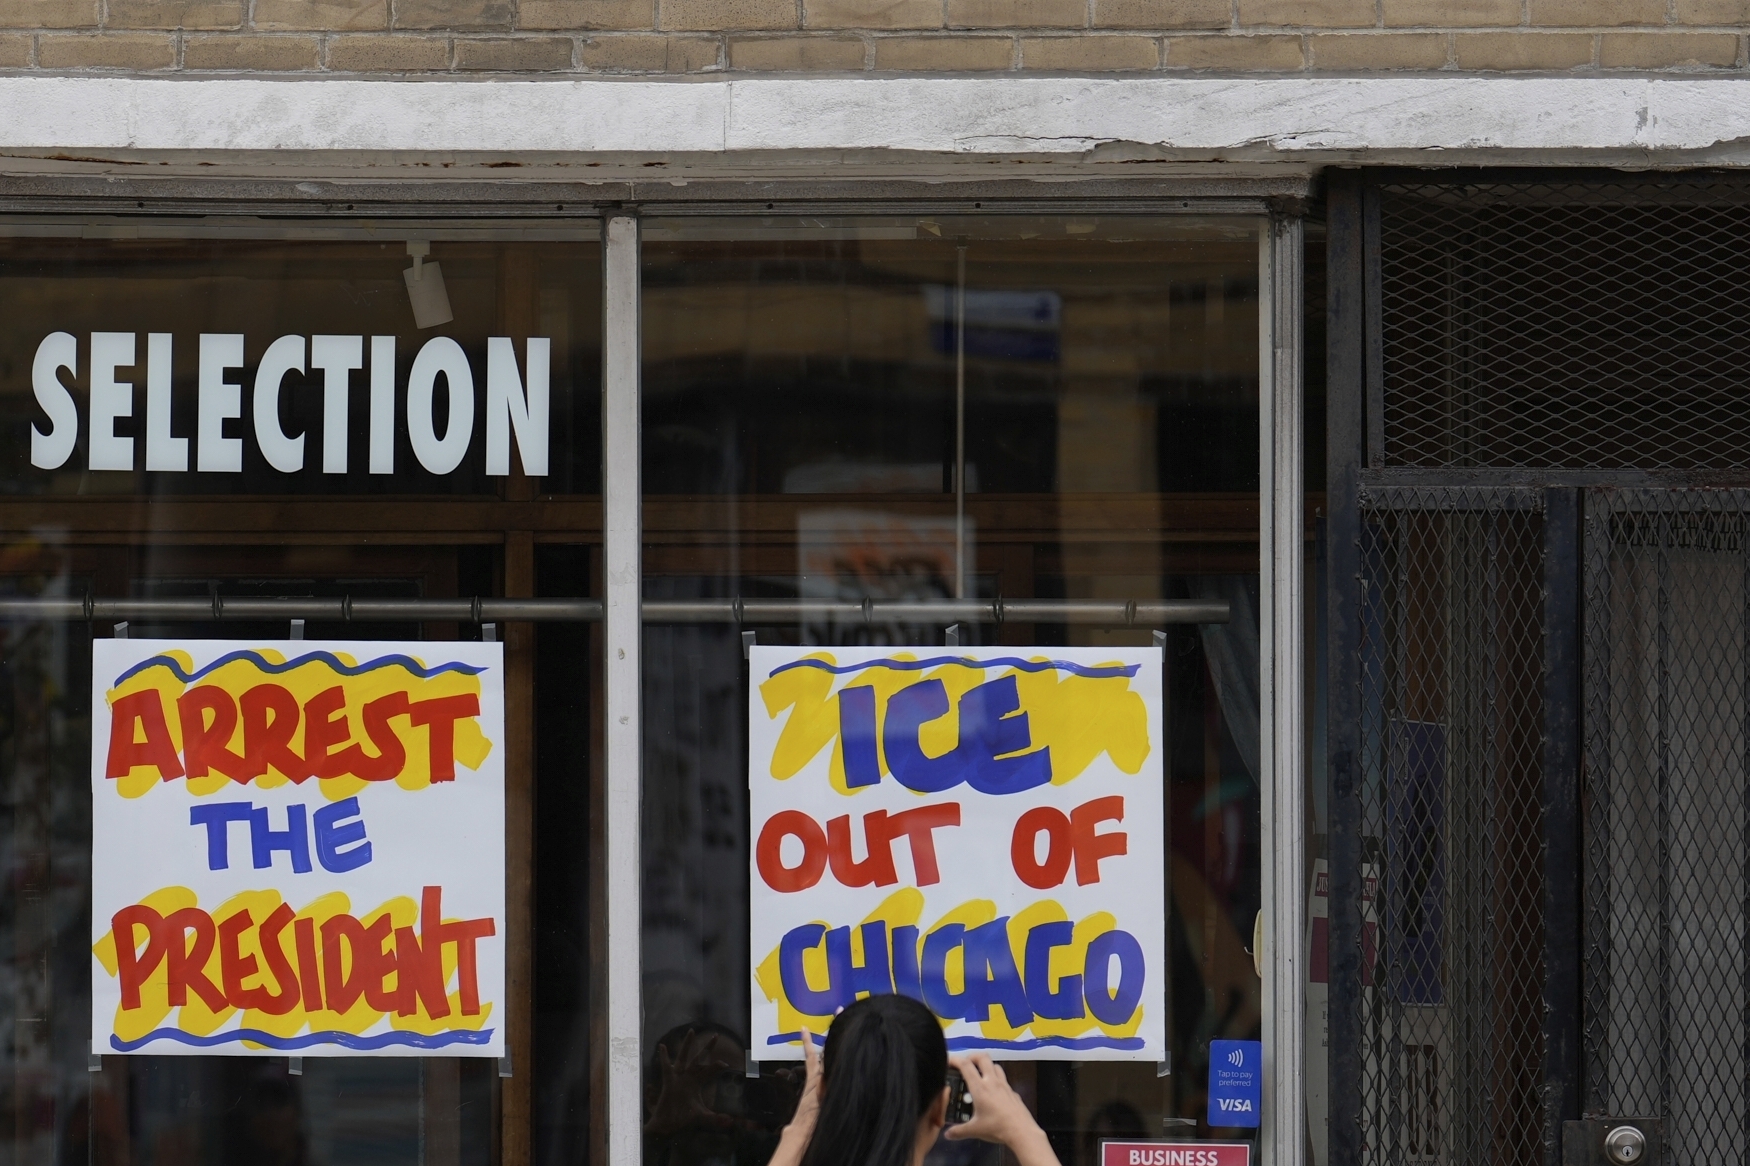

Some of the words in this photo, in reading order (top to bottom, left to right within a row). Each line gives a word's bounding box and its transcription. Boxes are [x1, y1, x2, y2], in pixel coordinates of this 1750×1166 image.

[30, 331, 550, 476] SELECTION
[105, 683, 481, 785] ARREST
[838, 674, 1052, 795] ICE
[190, 796, 372, 874] THE
[755, 802, 961, 893] OUT
[1010, 795, 1128, 890] OF
[111, 886, 495, 1020] PRESIDENT
[778, 915, 1145, 1029] CHICAGO
[1216, 1098, 1252, 1112] VISA
[1217, 1069, 1230, 1078] Tap
[1240, 1072, 1253, 1080] pay
[1218, 1079, 1251, 1087] preferred
[1129, 1150, 1218, 1166] BUSINESS
